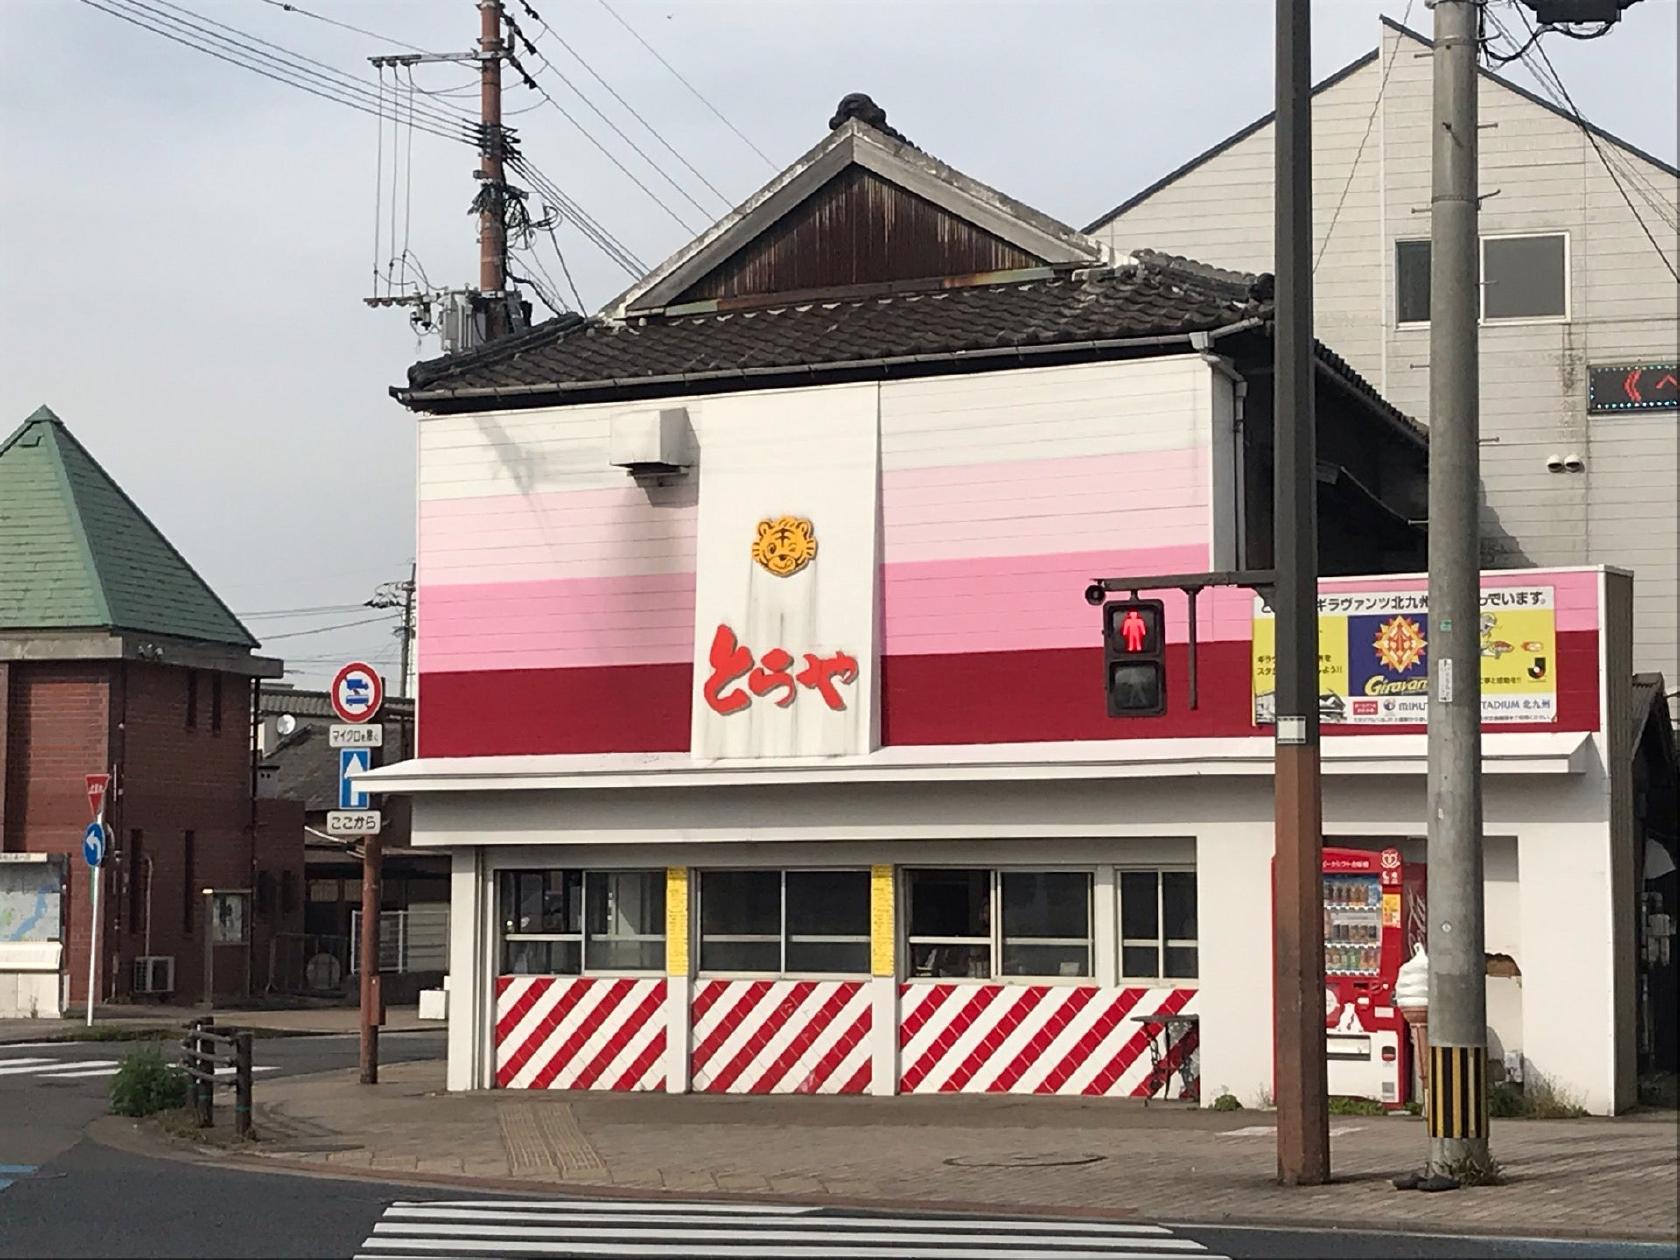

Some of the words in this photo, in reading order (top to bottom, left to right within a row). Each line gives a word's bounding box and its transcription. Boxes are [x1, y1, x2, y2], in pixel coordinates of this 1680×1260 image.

[704, 624, 859, 715] とらや
[332, 816, 376, 830] ここから
